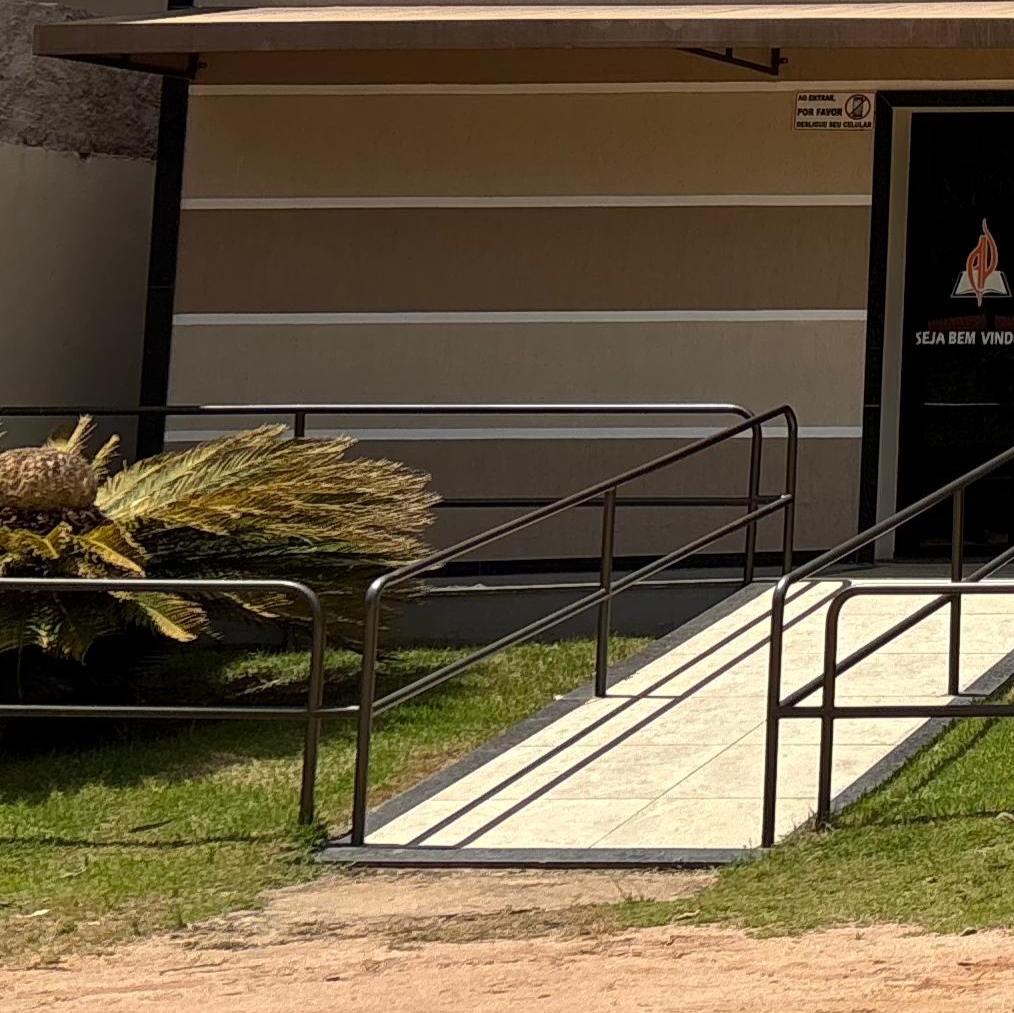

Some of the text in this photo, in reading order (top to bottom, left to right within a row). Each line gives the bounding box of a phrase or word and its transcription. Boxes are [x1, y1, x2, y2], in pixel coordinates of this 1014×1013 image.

[797, 108, 842, 116] POR FAVOR
[915, 331, 945, 345] SEJA
[948, 331, 976, 345] BEM
